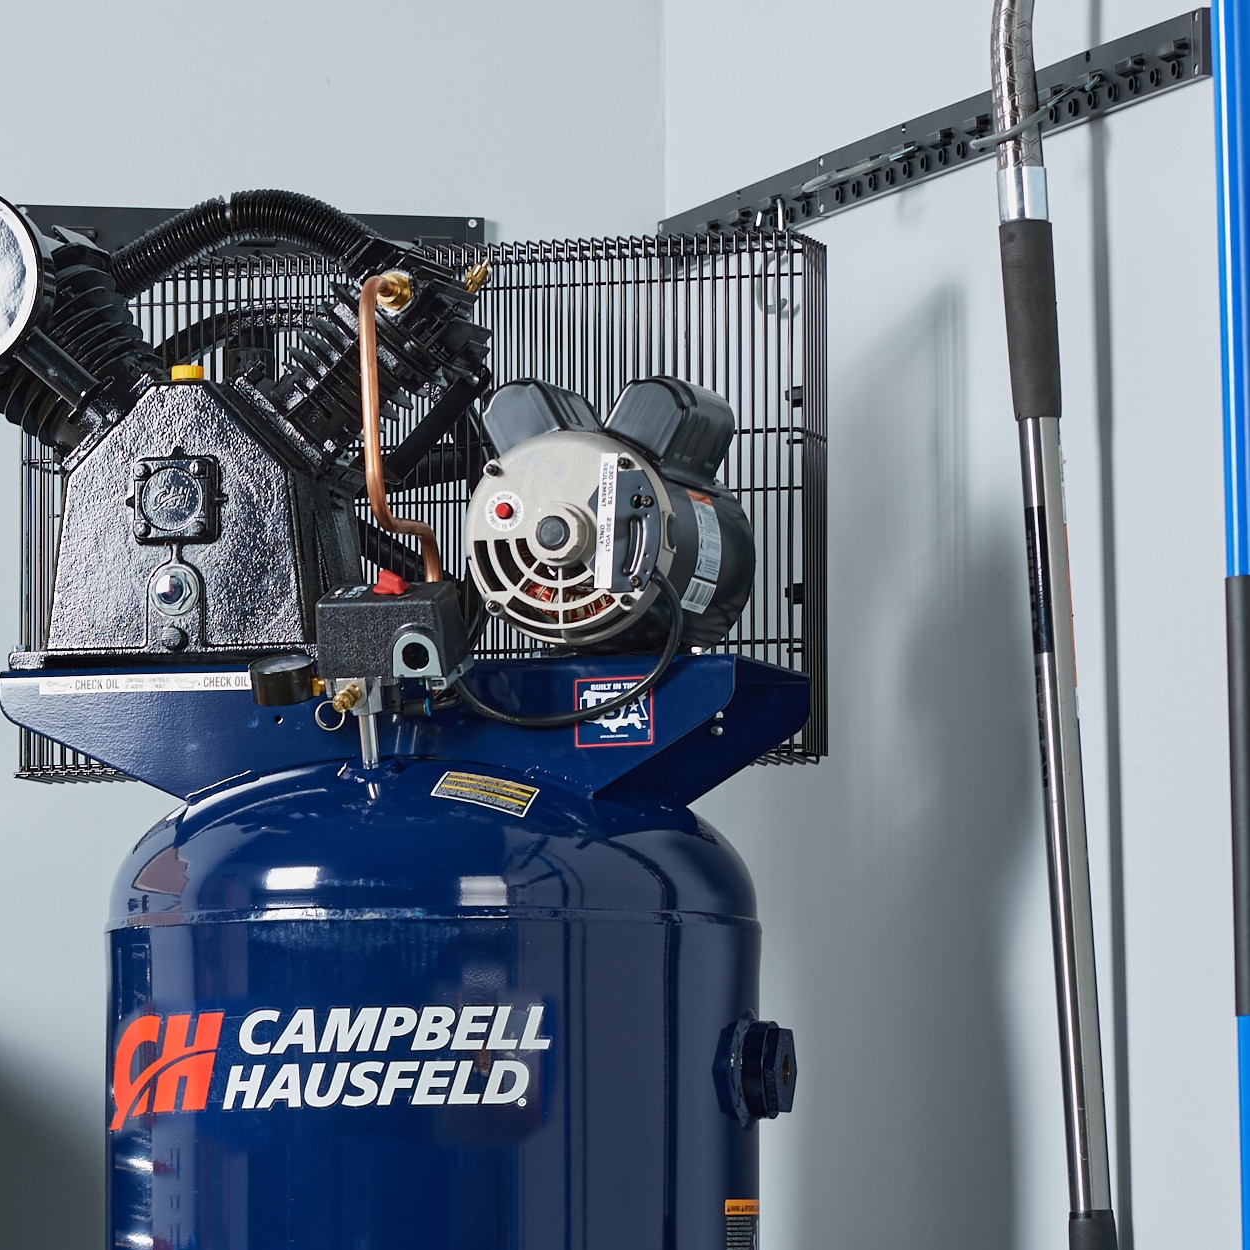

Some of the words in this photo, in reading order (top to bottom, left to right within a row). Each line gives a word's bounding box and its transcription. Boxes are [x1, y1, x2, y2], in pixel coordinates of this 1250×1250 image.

[74, 679, 103, 691] CHECK
[105, 678, 120, 690] OIL
[203, 676, 232, 688] CHECK
[234, 675, 249, 687] OIL
[612, 682, 622, 690] IN
[237, 1005, 552, 1055] CAMPBELL
[222, 1059, 531, 1111] HAUSFELD
